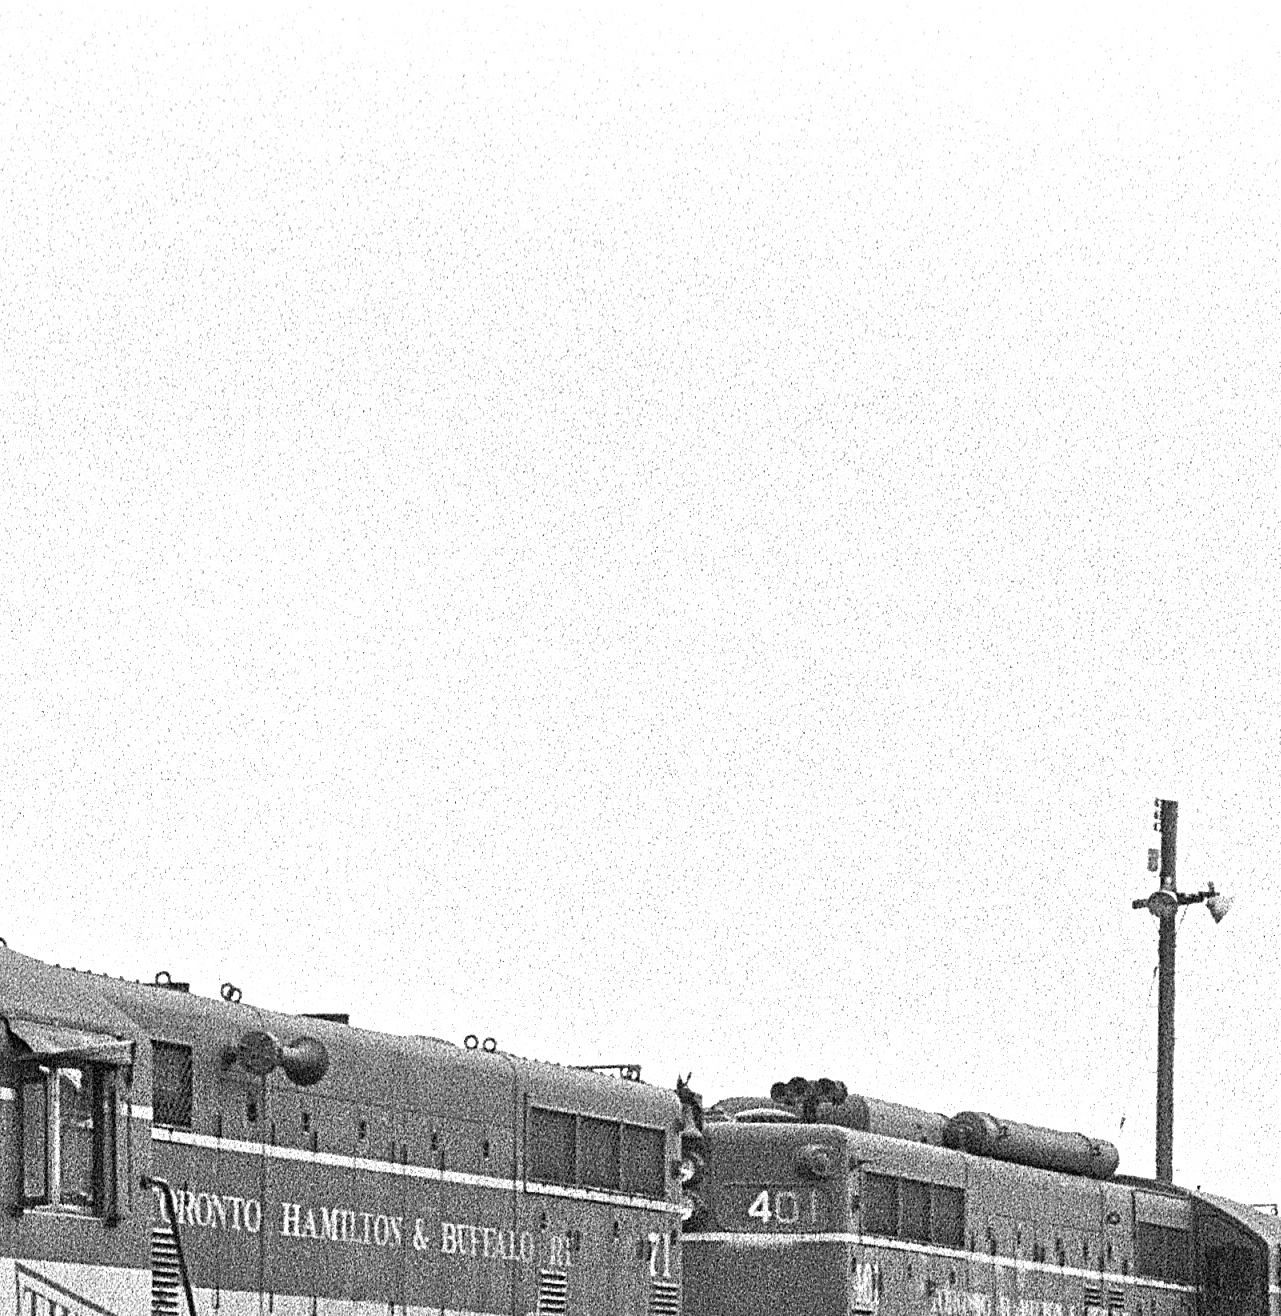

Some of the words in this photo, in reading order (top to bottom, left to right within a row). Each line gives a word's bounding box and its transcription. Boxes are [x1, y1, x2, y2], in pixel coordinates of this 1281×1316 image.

[152, 1187, 262, 1233] ORONTO
[281, 1202, 404, 1248] HAMILTON
[412, 1218, 430, 1251] &
[441, 1221, 535, 1263] BUFFALO
[747, 1189, 817, 1224] 401
[648, 1231, 673, 1278] 71
